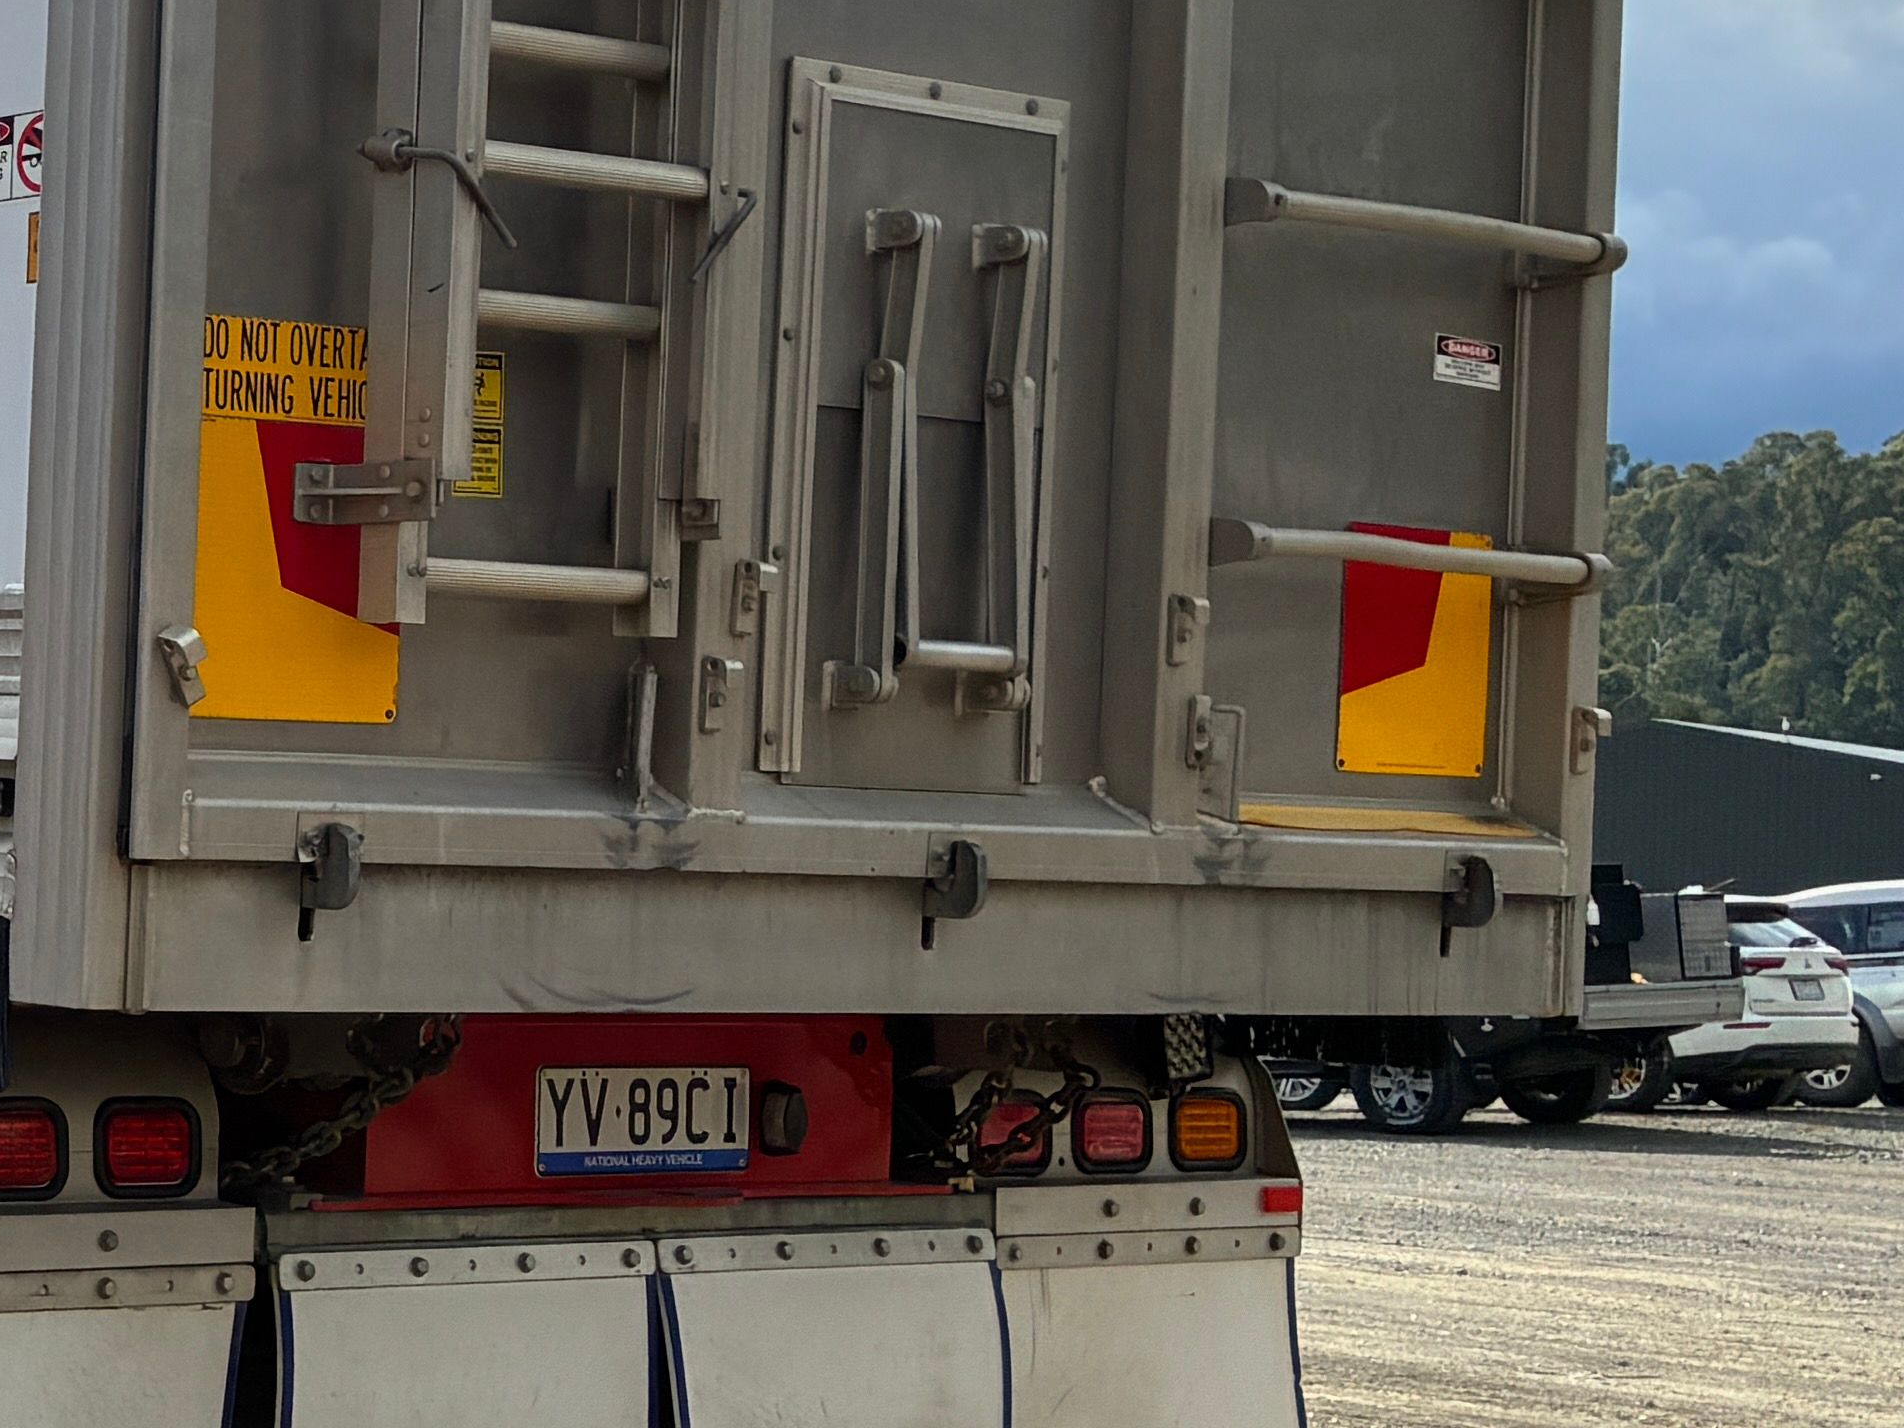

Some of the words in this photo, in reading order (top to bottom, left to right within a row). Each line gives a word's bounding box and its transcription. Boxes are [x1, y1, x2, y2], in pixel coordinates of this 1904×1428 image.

[204, 317, 229, 359] DO
[241, 319, 281, 363] NOT
[290, 324, 368, 370] OVERTA
[203, 368, 294, 414] TURNING
[309, 376, 367, 420] VEHIC
[584, 1155, 630, 1167] NATIONAL
[632, 1154, 663, 1166] HEAVY
[666, 1153, 703, 1165] VEHICLE
